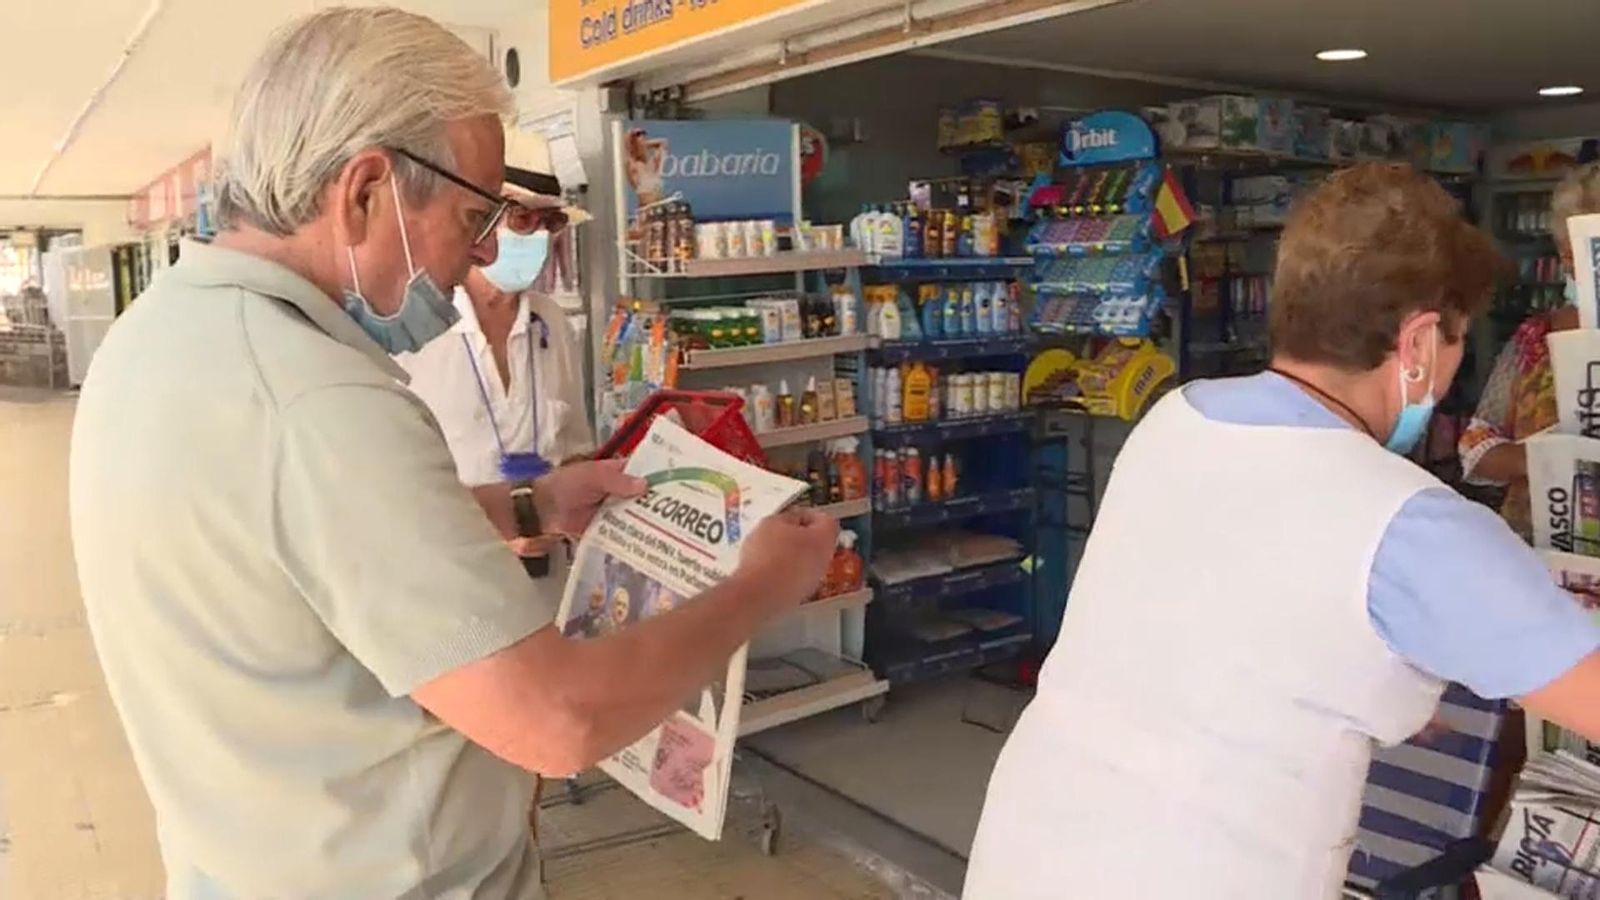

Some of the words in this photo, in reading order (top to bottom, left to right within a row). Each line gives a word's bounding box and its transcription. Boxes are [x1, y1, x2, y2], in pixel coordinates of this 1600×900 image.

[580, 8, 617, 48] Cold
[1065, 128, 1120, 153] Orbit
[660, 147, 780, 177] babaria
[652, 497, 724, 544] CORREO
